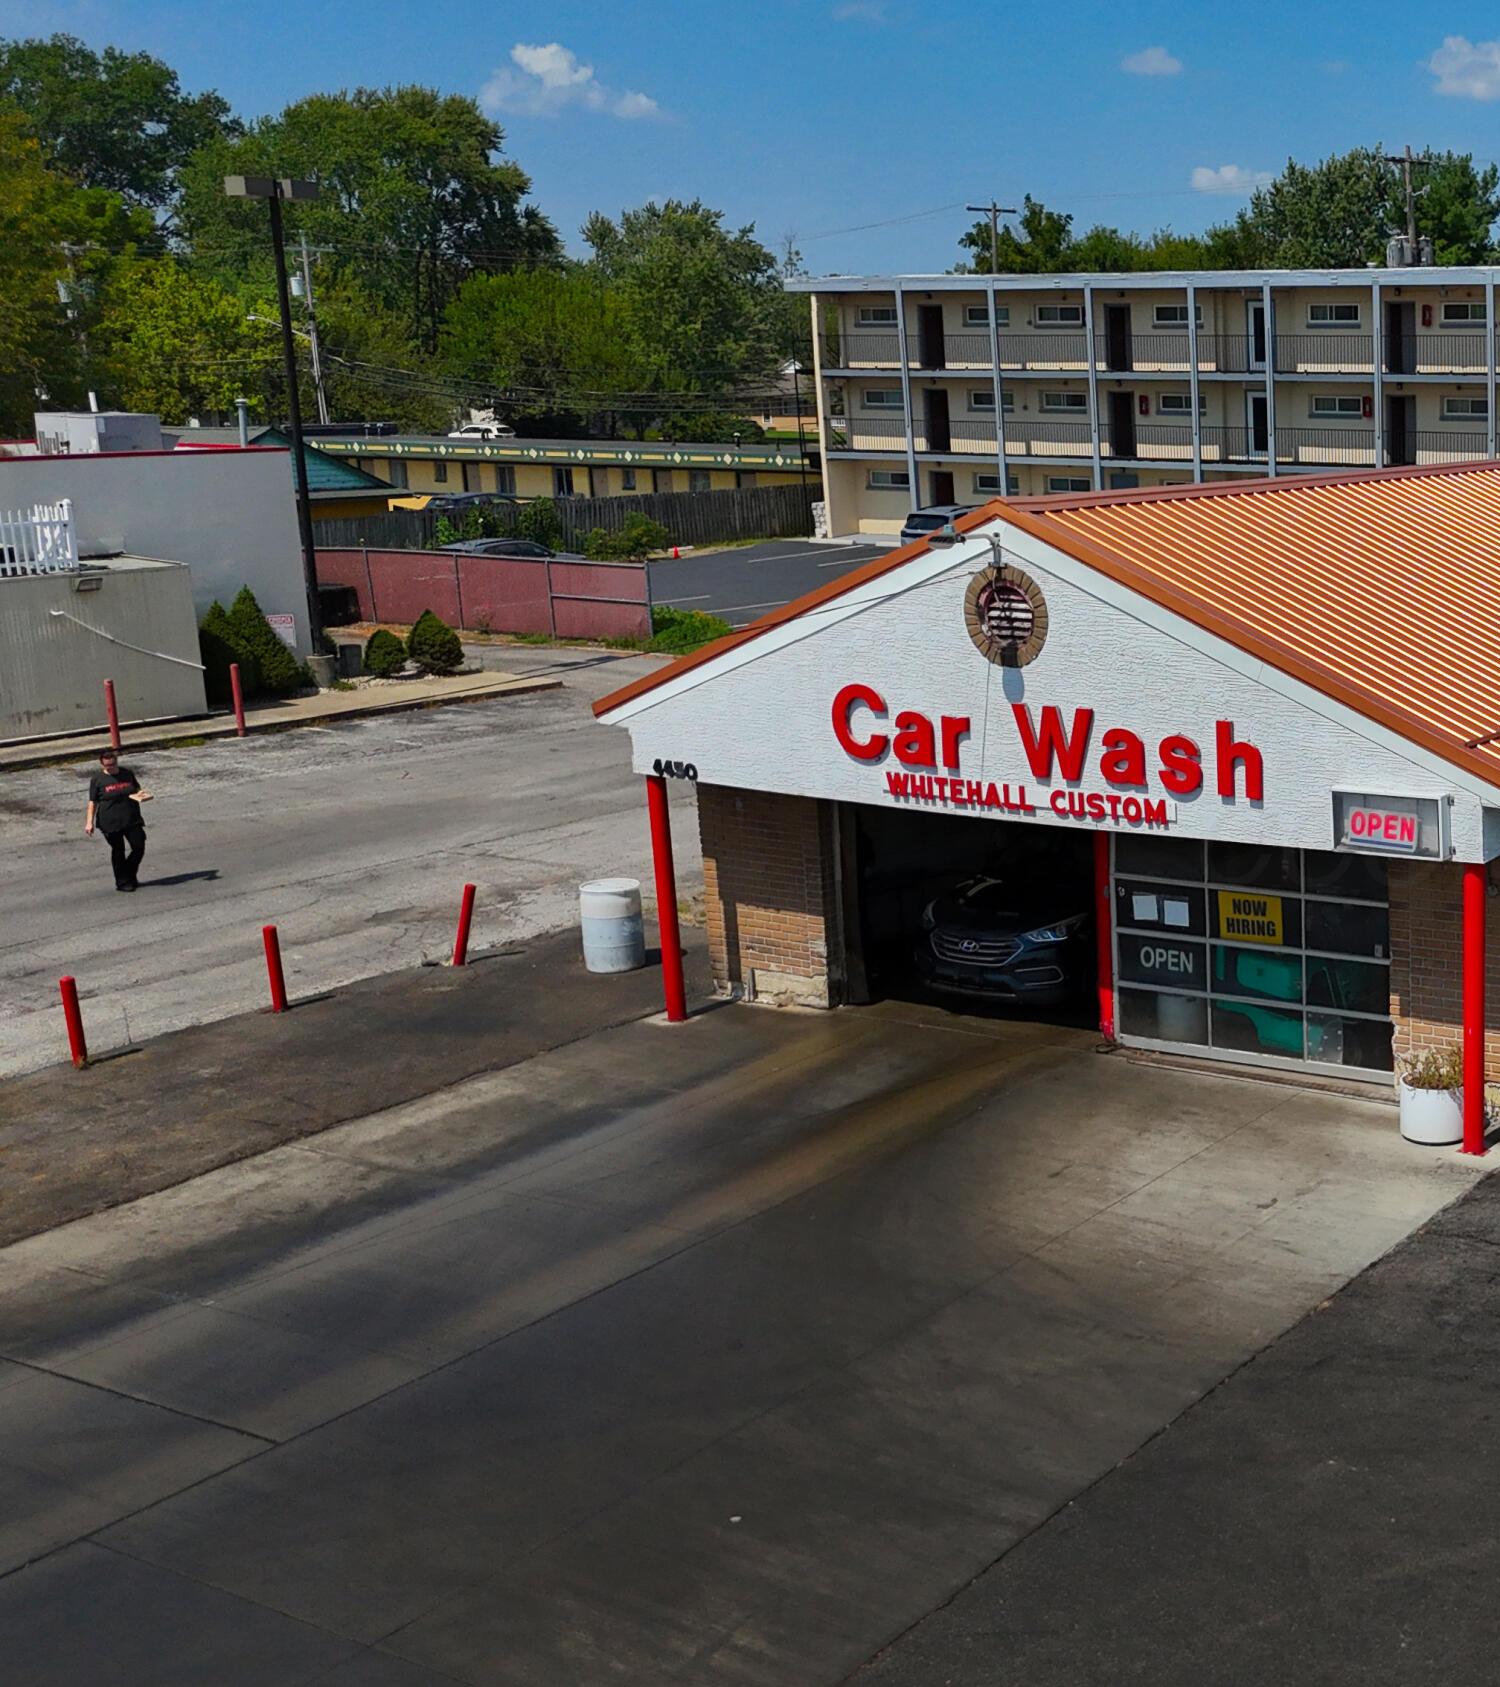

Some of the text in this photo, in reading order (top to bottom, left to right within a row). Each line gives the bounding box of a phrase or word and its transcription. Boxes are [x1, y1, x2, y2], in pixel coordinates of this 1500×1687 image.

[831, 684, 1263, 801] Car Wash
[652, 758, 699, 781] 4450
[885, 772, 1170, 826] WHITEHALL CUSTOM
[1350, 810, 1416, 843] OPEN
[1231, 898, 1267, 917] NOW
[1226, 917, 1277, 937] HIRING
[1139, 945, 1194, 974] OPEN
